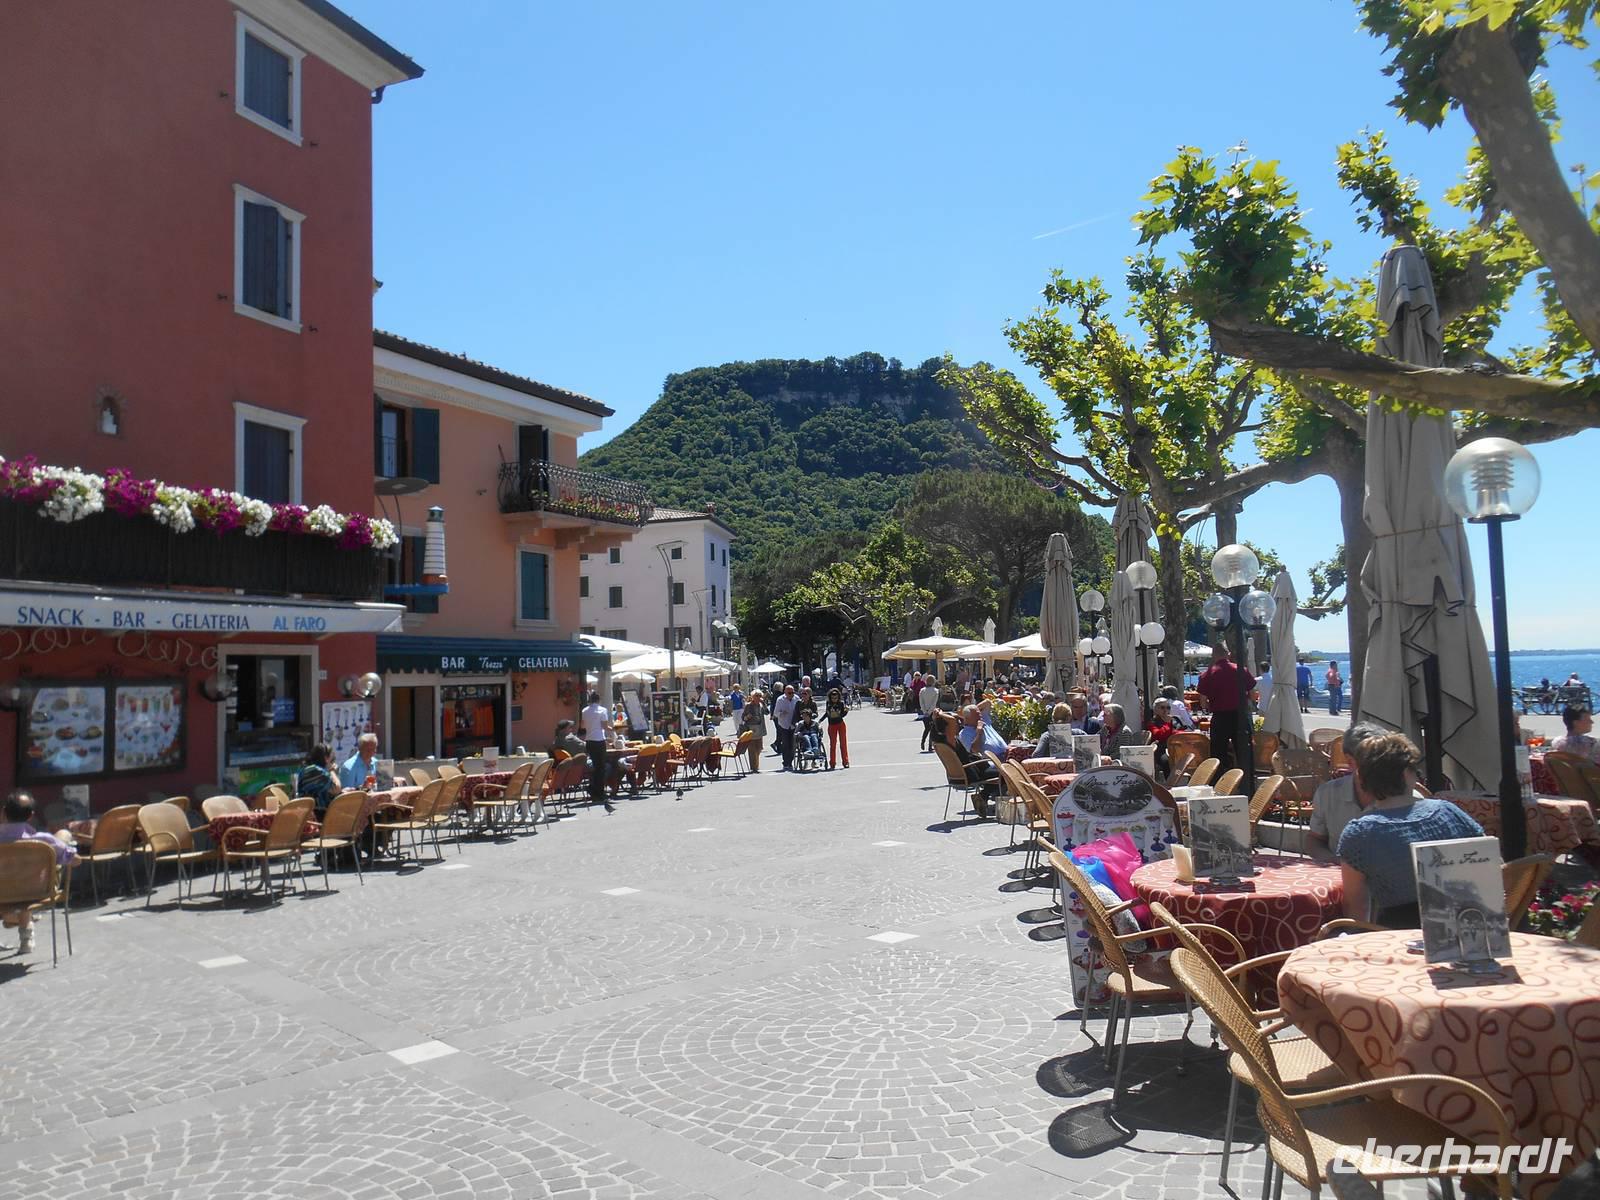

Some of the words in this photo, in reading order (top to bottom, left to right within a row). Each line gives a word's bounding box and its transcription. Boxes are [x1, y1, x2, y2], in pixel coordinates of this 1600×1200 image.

[17, 606, 84, 626] SNACK
[113, 611, 145, 628] BAR
[172, 613, 250, 630] GELATERIA
[273, 616, 289, 631] AL
[294, 616, 326, 631] FARO
[441, 657, 465, 669] BAR
[519, 657, 569, 668] GELATERIA
